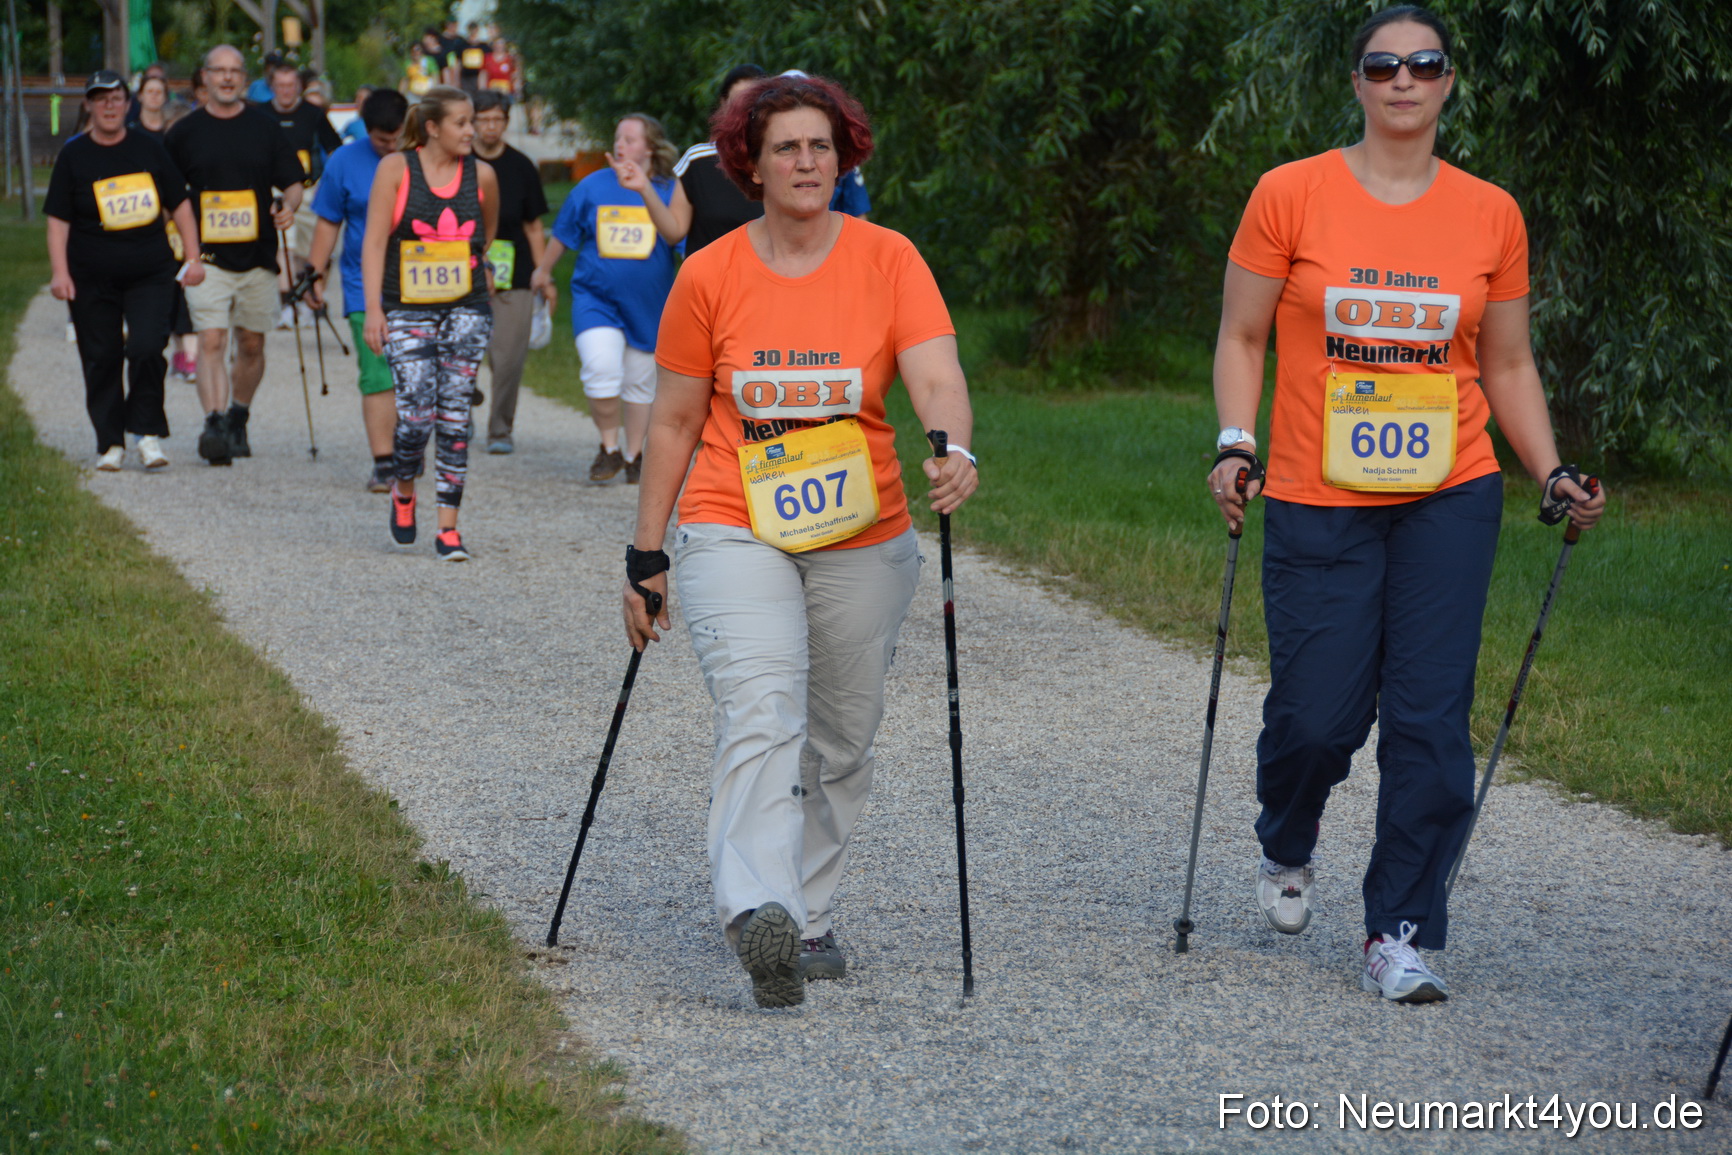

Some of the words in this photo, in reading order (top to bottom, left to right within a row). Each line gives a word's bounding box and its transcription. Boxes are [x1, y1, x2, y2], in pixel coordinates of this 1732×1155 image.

[106, 194, 152, 216] 1274
[208, 211, 251, 228] 1260
[608, 226, 643, 244] 729
[408, 265, 461, 285] 1181
[1350, 267, 1379, 285] 30
[1384, 270, 1439, 289] Jahre
[1335, 298, 1449, 330] OBI
[753, 350, 781, 366] 30
[787, 349, 840, 366] Jahre
[1326, 336, 1451, 365] Neumarkt
[742, 380, 852, 408] OBI
[1345, 392, 1393, 402] firmenlauf
[1351, 421, 1430, 459] 608
[760, 451, 804, 469] firmenlauf
[1362, 467, 1385, 475] Nadja
[774, 469, 848, 520] 607
[780, 525, 815, 538] Michaela
[815, 512, 859, 529] Schaffrinski
